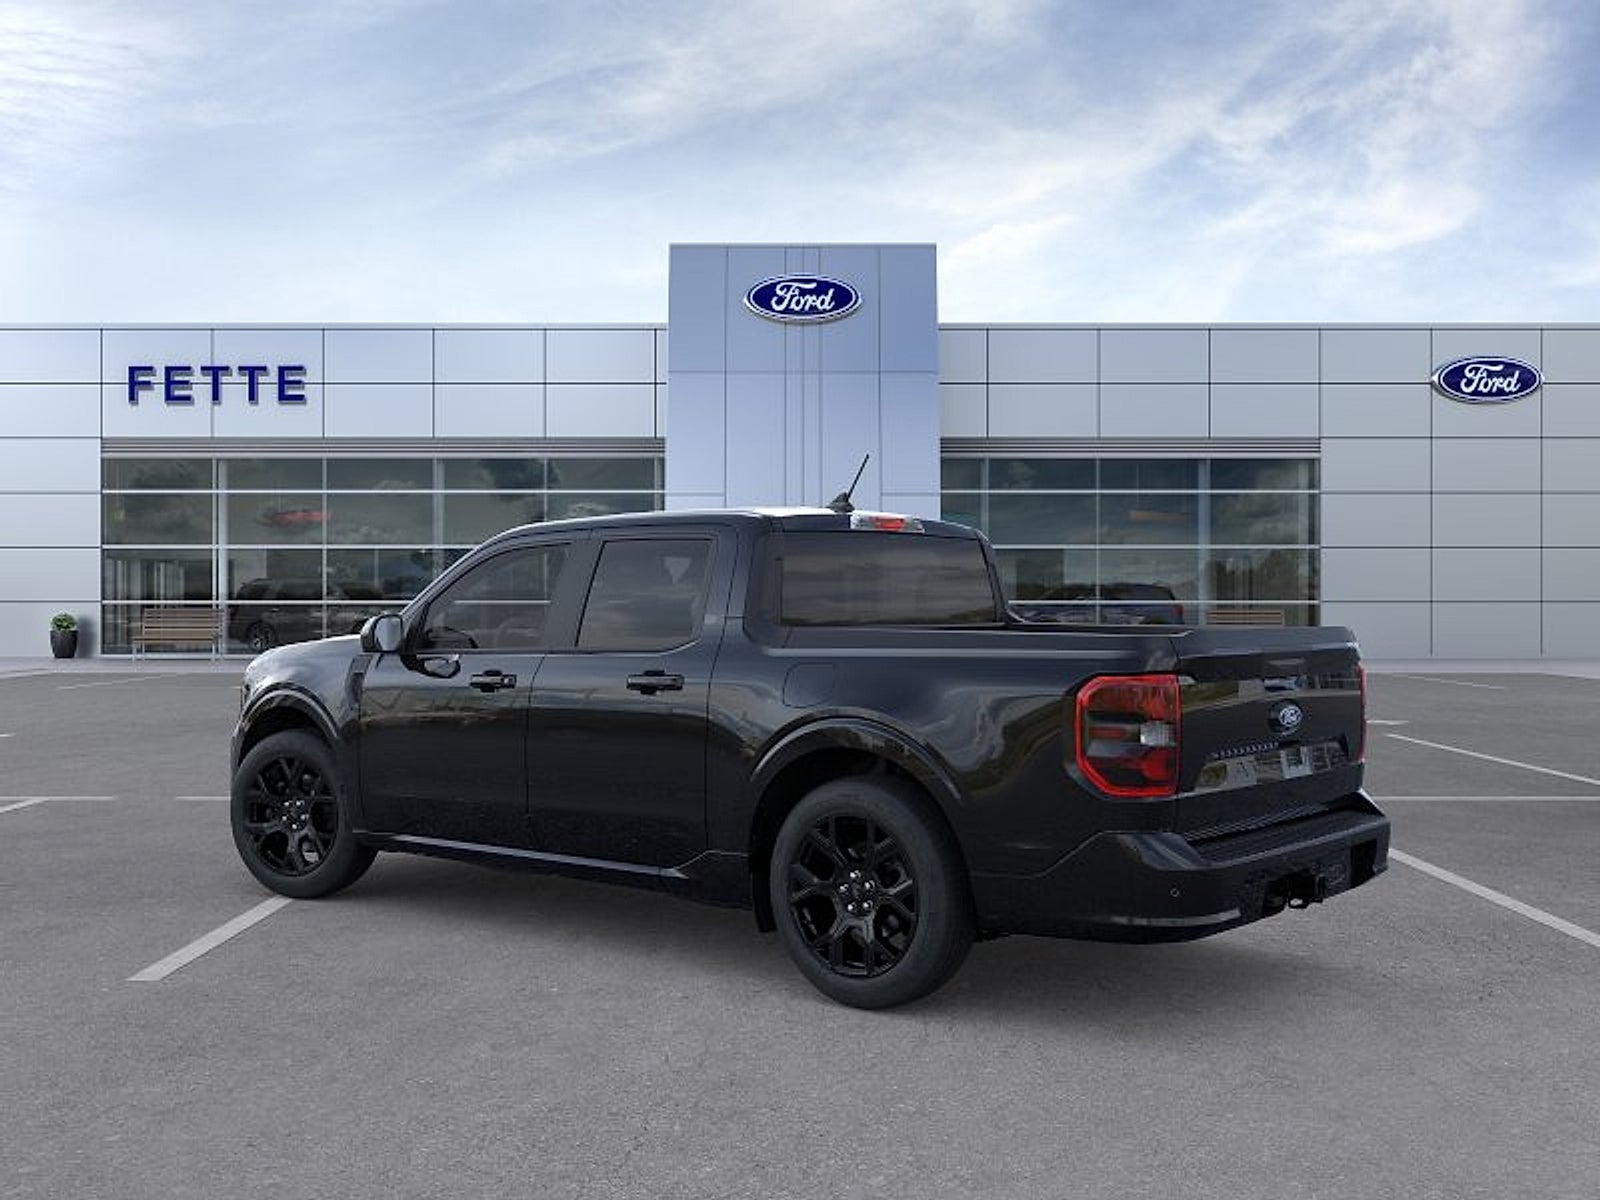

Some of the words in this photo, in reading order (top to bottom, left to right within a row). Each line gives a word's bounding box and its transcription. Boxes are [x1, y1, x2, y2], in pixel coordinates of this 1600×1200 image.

[771, 282, 835, 311] Ford
[128, 365, 306, 402] FETTE
[1460, 364, 1521, 393] Ford
